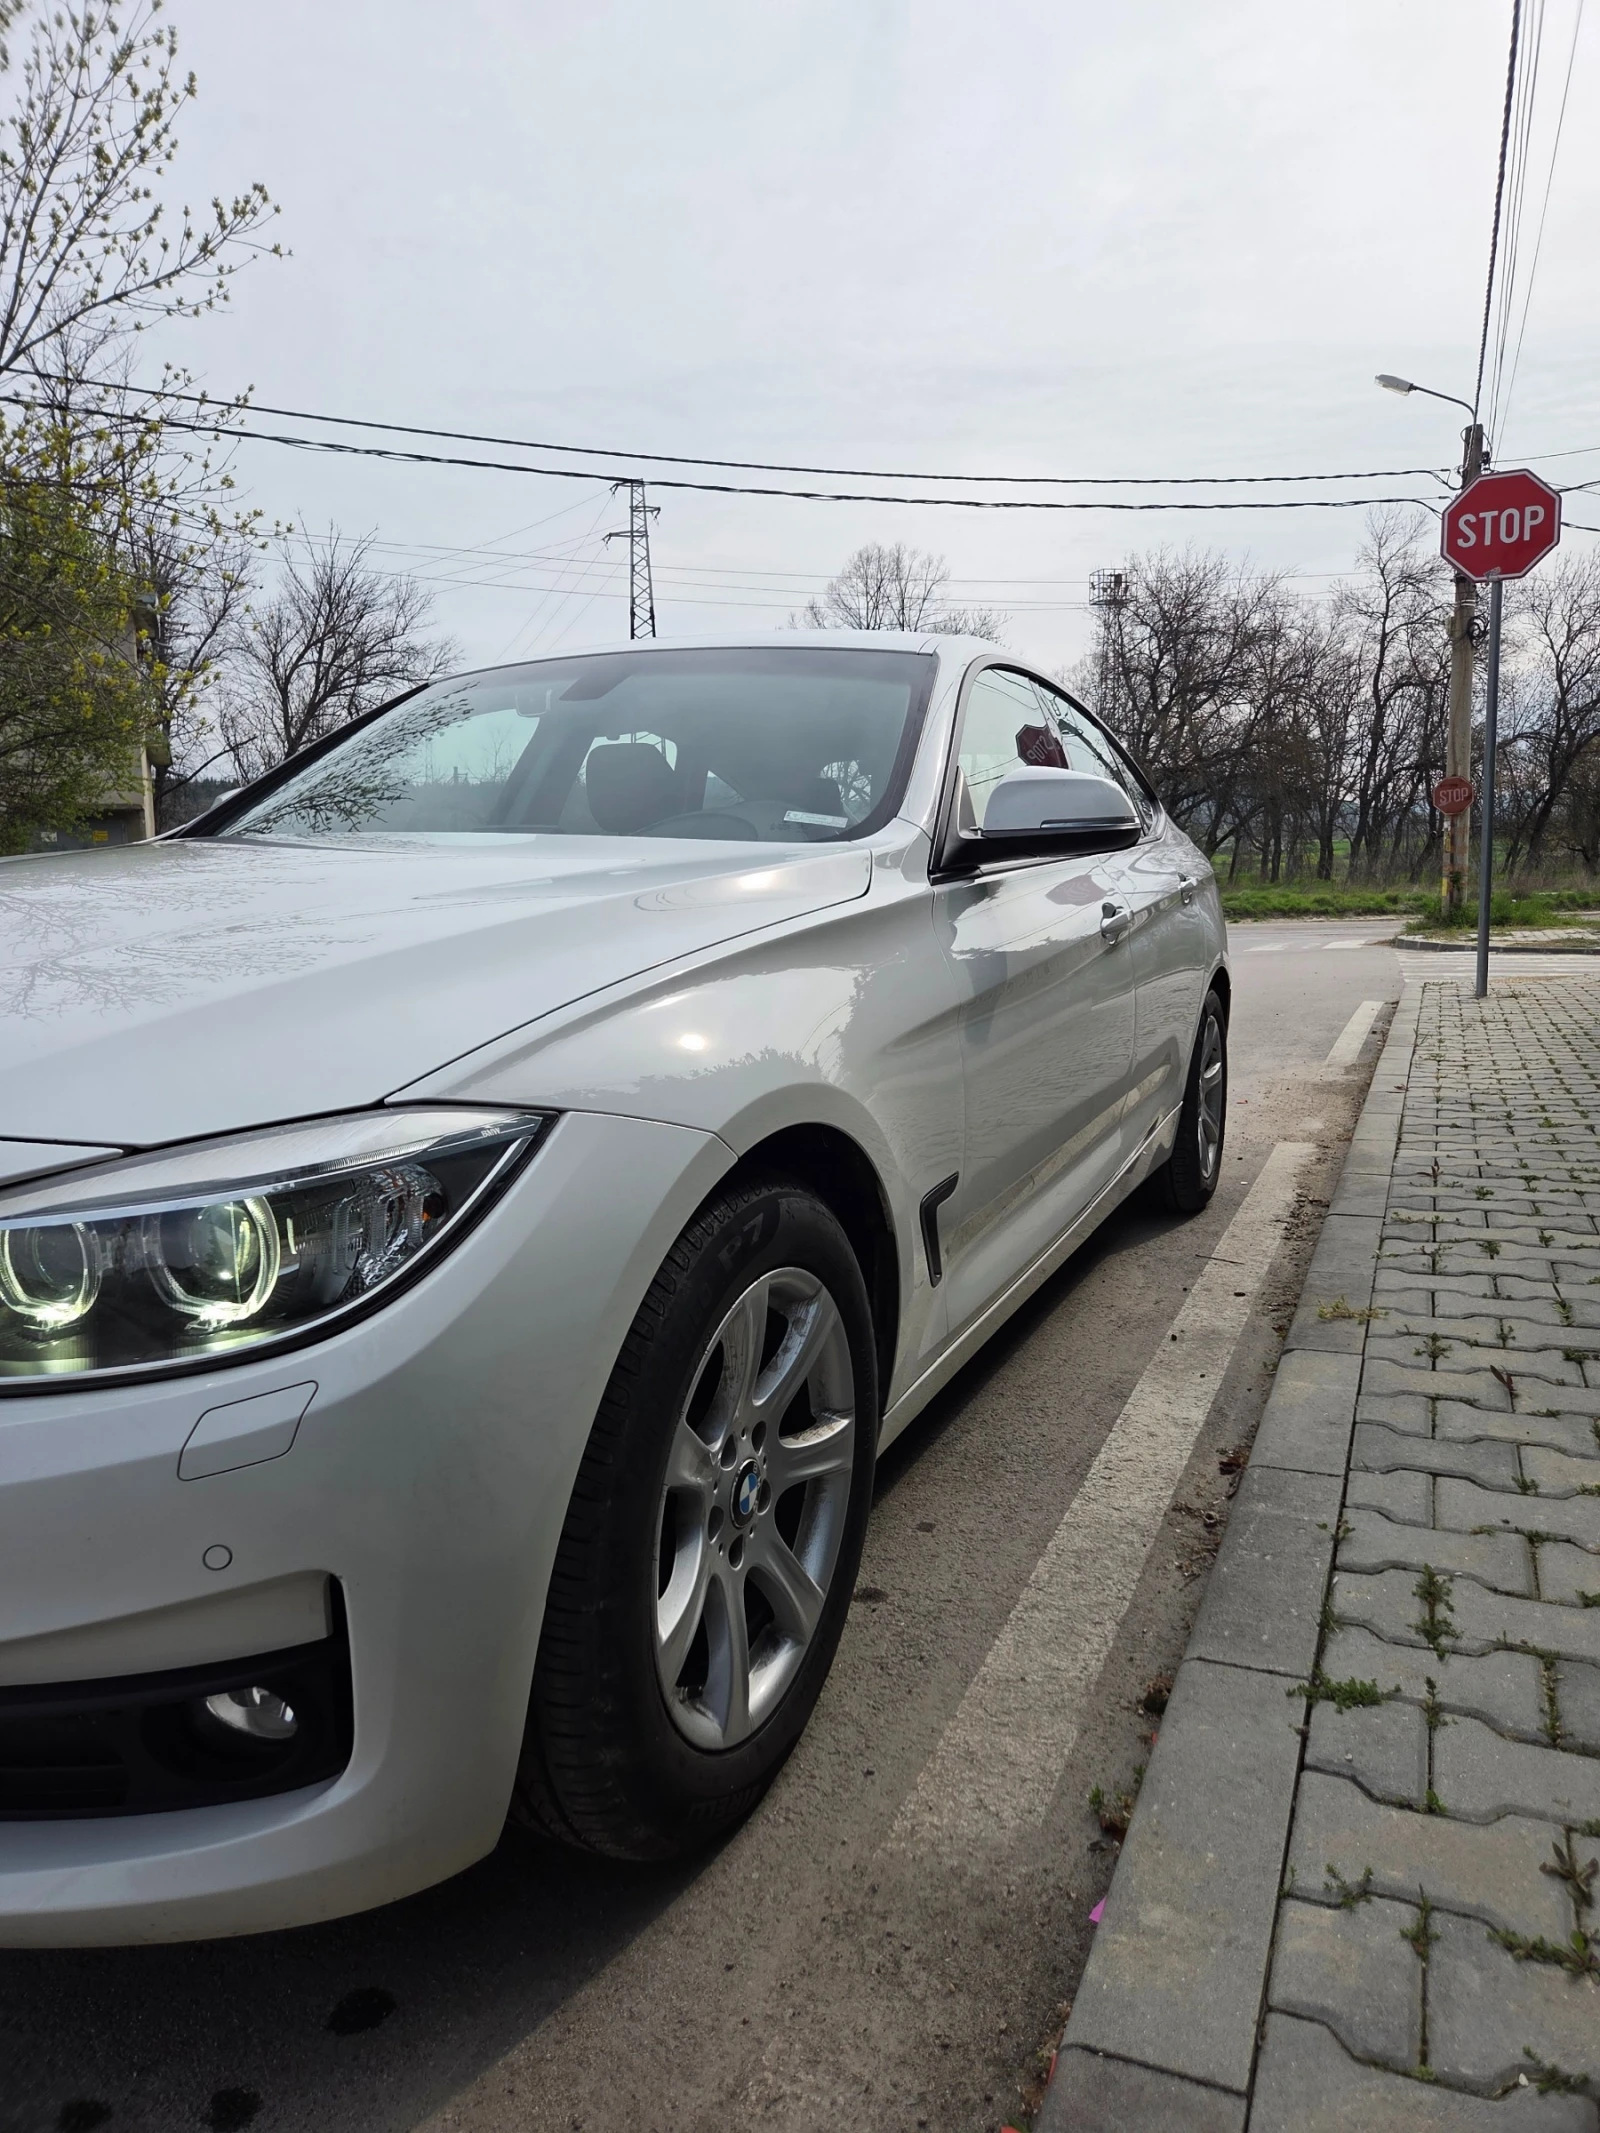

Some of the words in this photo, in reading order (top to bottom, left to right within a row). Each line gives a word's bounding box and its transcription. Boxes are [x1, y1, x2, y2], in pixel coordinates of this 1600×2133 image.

[1456, 505, 1545, 548] STOP
[1439, 787, 1469, 804] STOP
[480, 1127, 501, 1138] BMW
